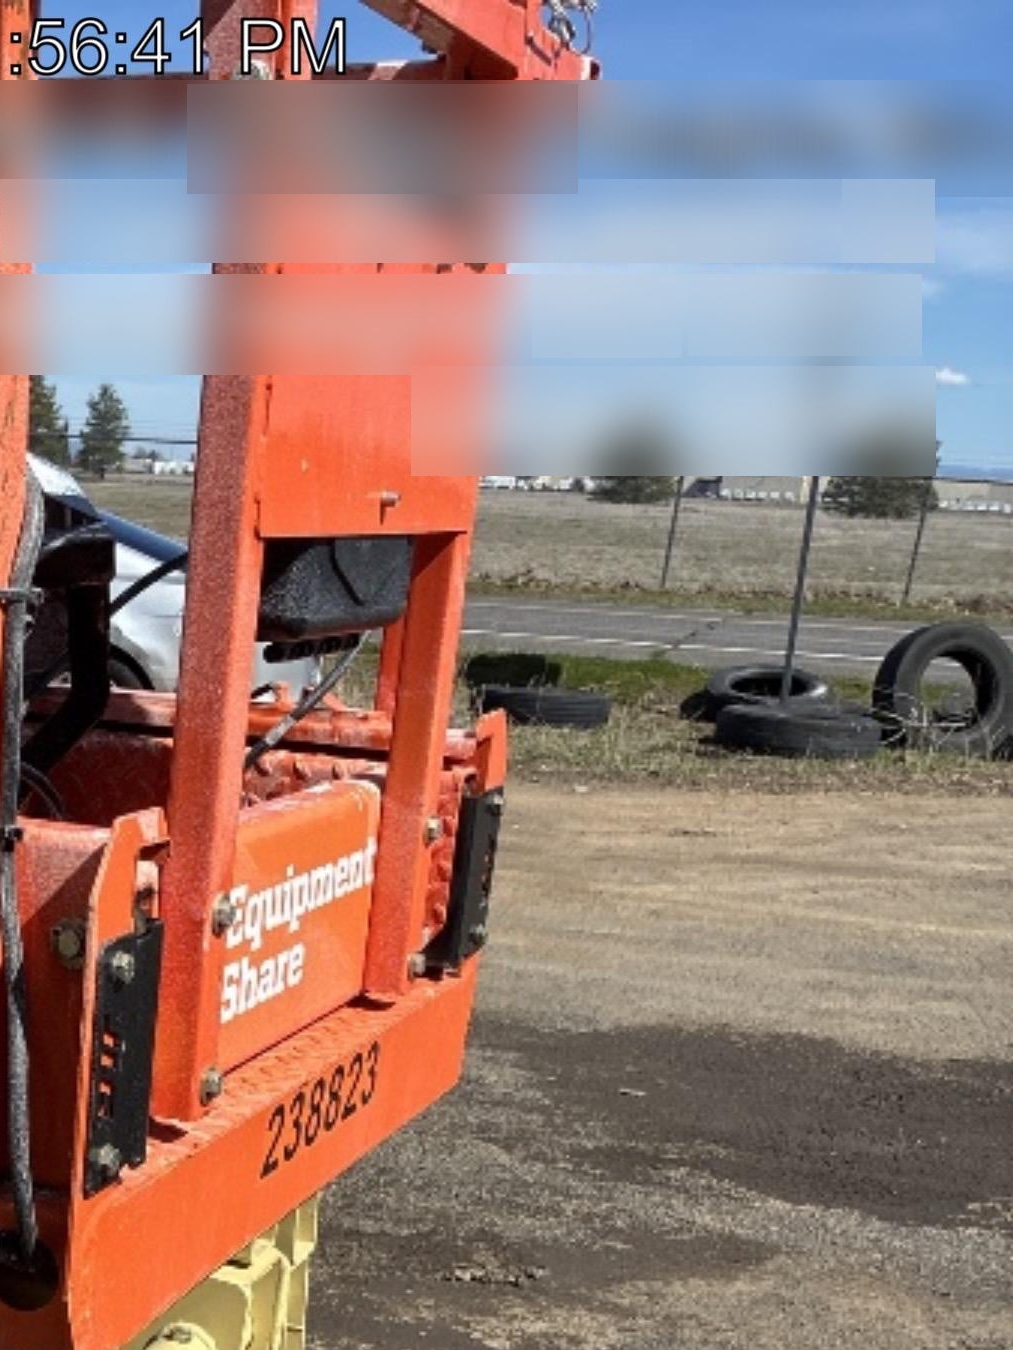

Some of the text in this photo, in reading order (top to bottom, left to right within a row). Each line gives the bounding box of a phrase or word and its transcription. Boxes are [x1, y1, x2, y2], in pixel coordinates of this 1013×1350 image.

[226, 842, 376, 951] Equipment
[220, 943, 306, 1024] Share
[260, 1040, 381, 1179] 238823
